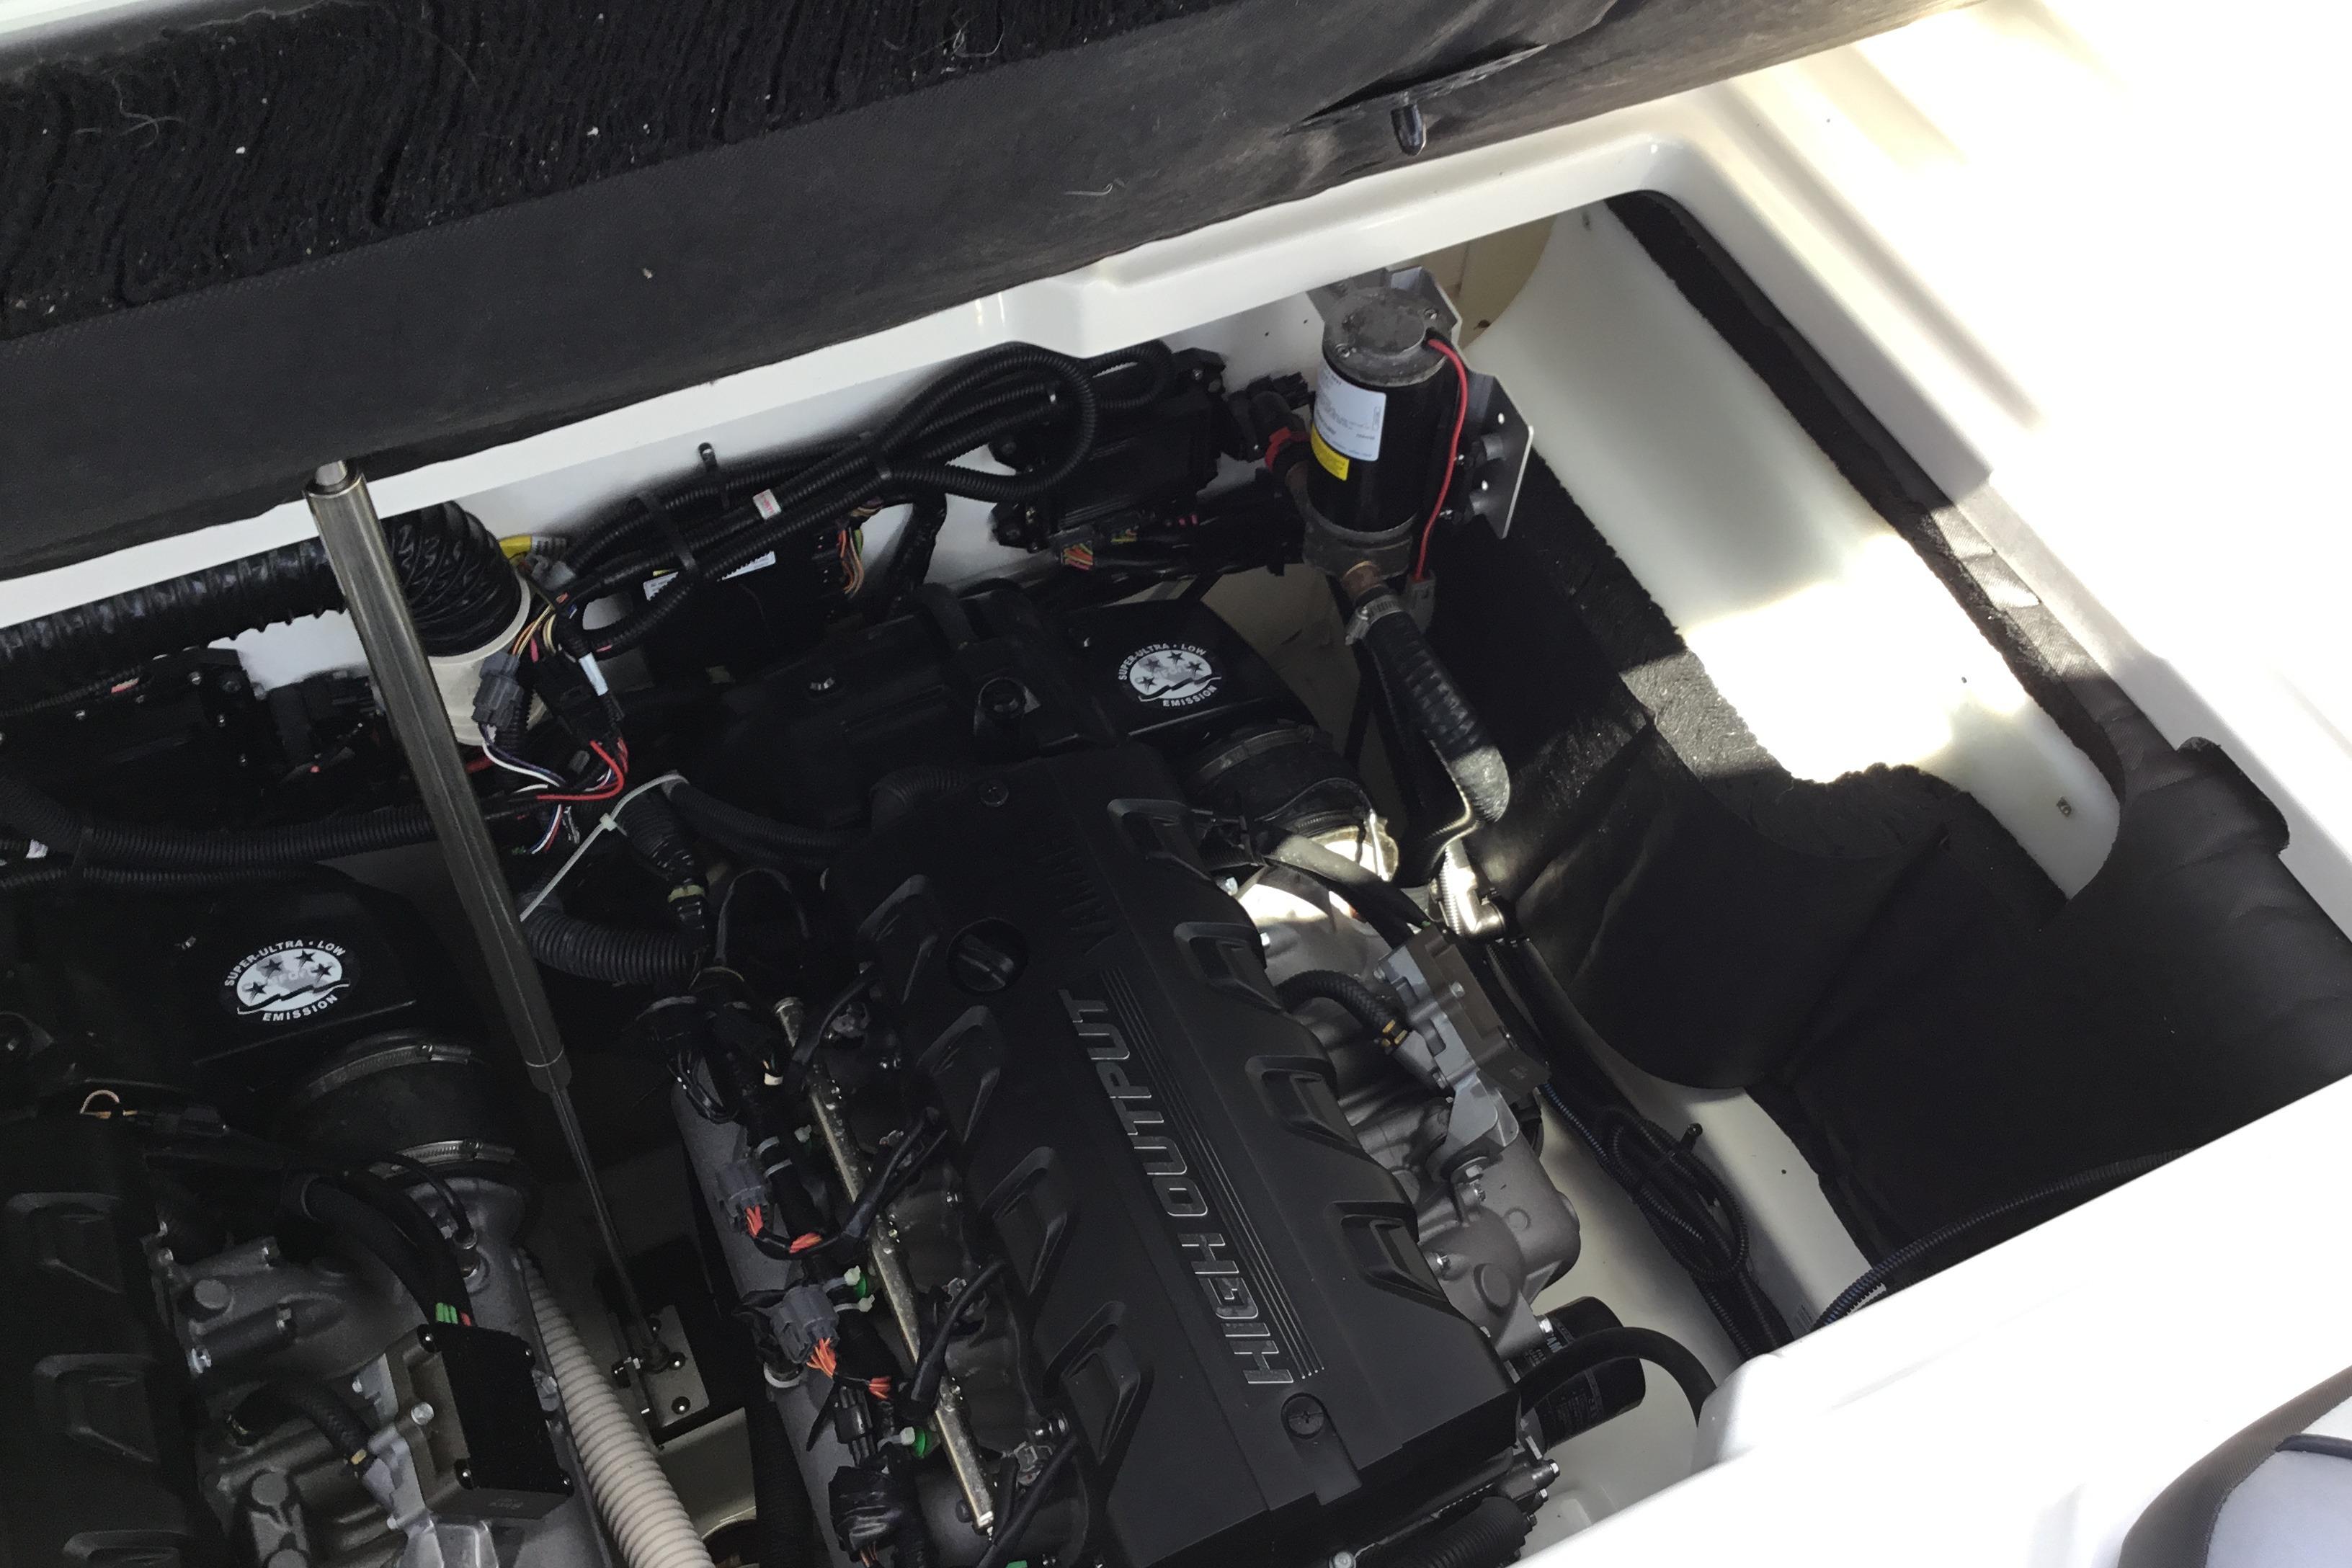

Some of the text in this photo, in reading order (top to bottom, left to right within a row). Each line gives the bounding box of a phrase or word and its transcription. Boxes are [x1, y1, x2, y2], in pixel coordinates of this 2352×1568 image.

[1118, 643, 1170, 680] SUPER-ULTRA
[1181, 643, 1207, 656] LOW
[1163, 685, 1218, 708] EMISSION
[224, 939, 303, 986] SUPER-ULTRA
[317, 940, 347, 956] LOW
[262, 994, 338, 1022] EMISSION
[1058, 989, 1208, 1217] OUTPUT
[1177, 1232, 1294, 1384] HIGH
